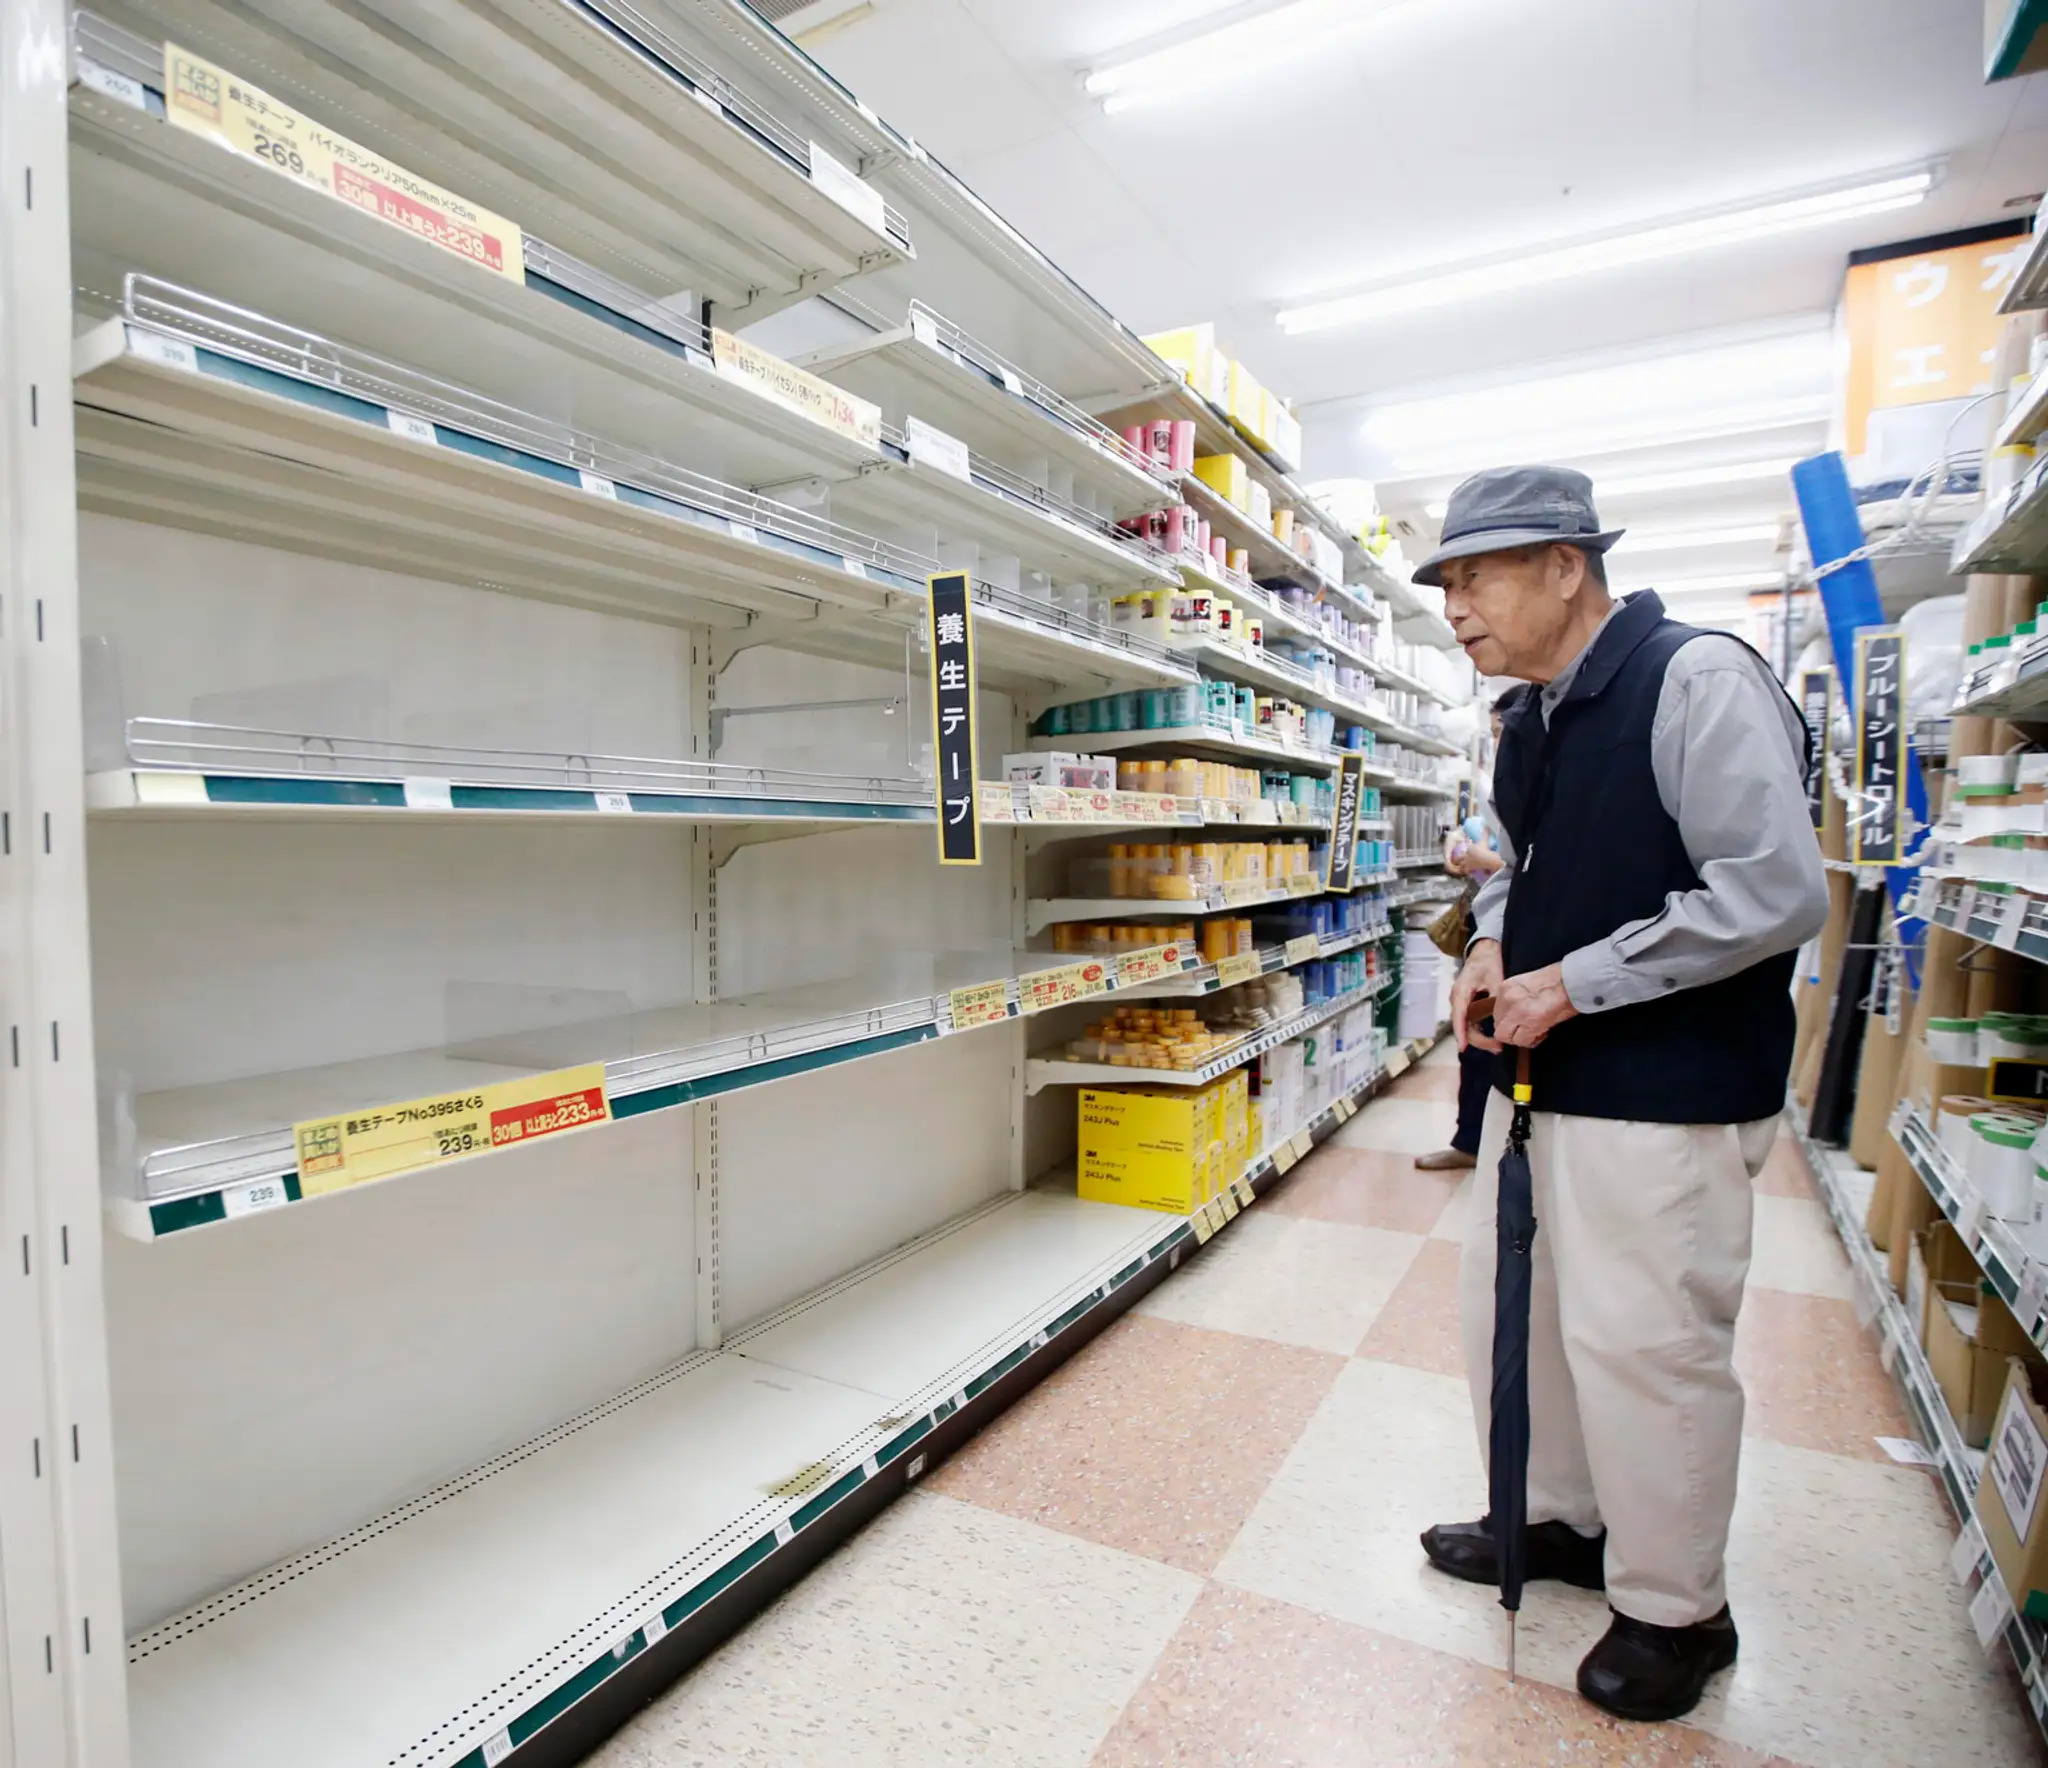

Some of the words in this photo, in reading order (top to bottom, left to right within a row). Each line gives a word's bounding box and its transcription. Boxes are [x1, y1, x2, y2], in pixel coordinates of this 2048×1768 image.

[253, 134, 304, 175] 269
[937, 612, 971, 825] 養生テープ
[1863, 653, 1898, 845] ブルーシートロール
[1333, 772, 1359, 873] マスキングテープ
[346, 1095, 484, 1136] 養生テープNo395さくら
[439, 1134, 473, 1156] 239
[1085, 1150, 1097, 1158] 3M
[249, 1187, 274, 1202] 239
